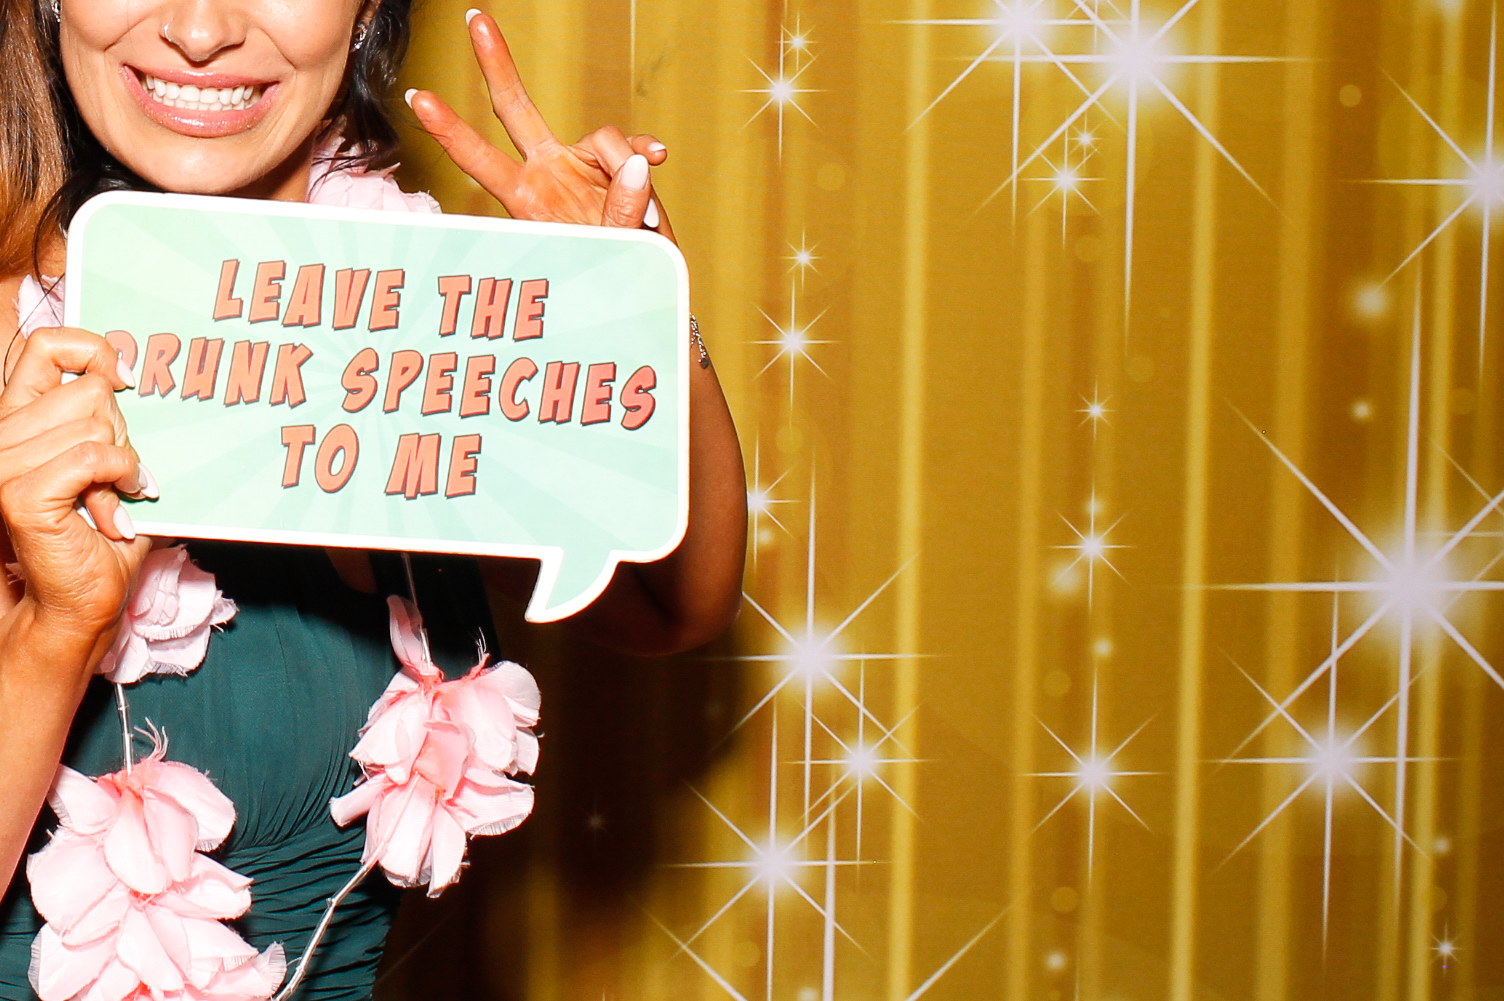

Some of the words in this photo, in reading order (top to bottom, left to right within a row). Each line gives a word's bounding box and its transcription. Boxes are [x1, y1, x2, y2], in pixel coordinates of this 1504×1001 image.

[212, 259, 406, 333] LEAVE
[438, 274, 550, 342] THE
[340, 347, 658, 431] SPEECHES
[280, 423, 360, 494] TO
[384, 432, 483, 500] ME
